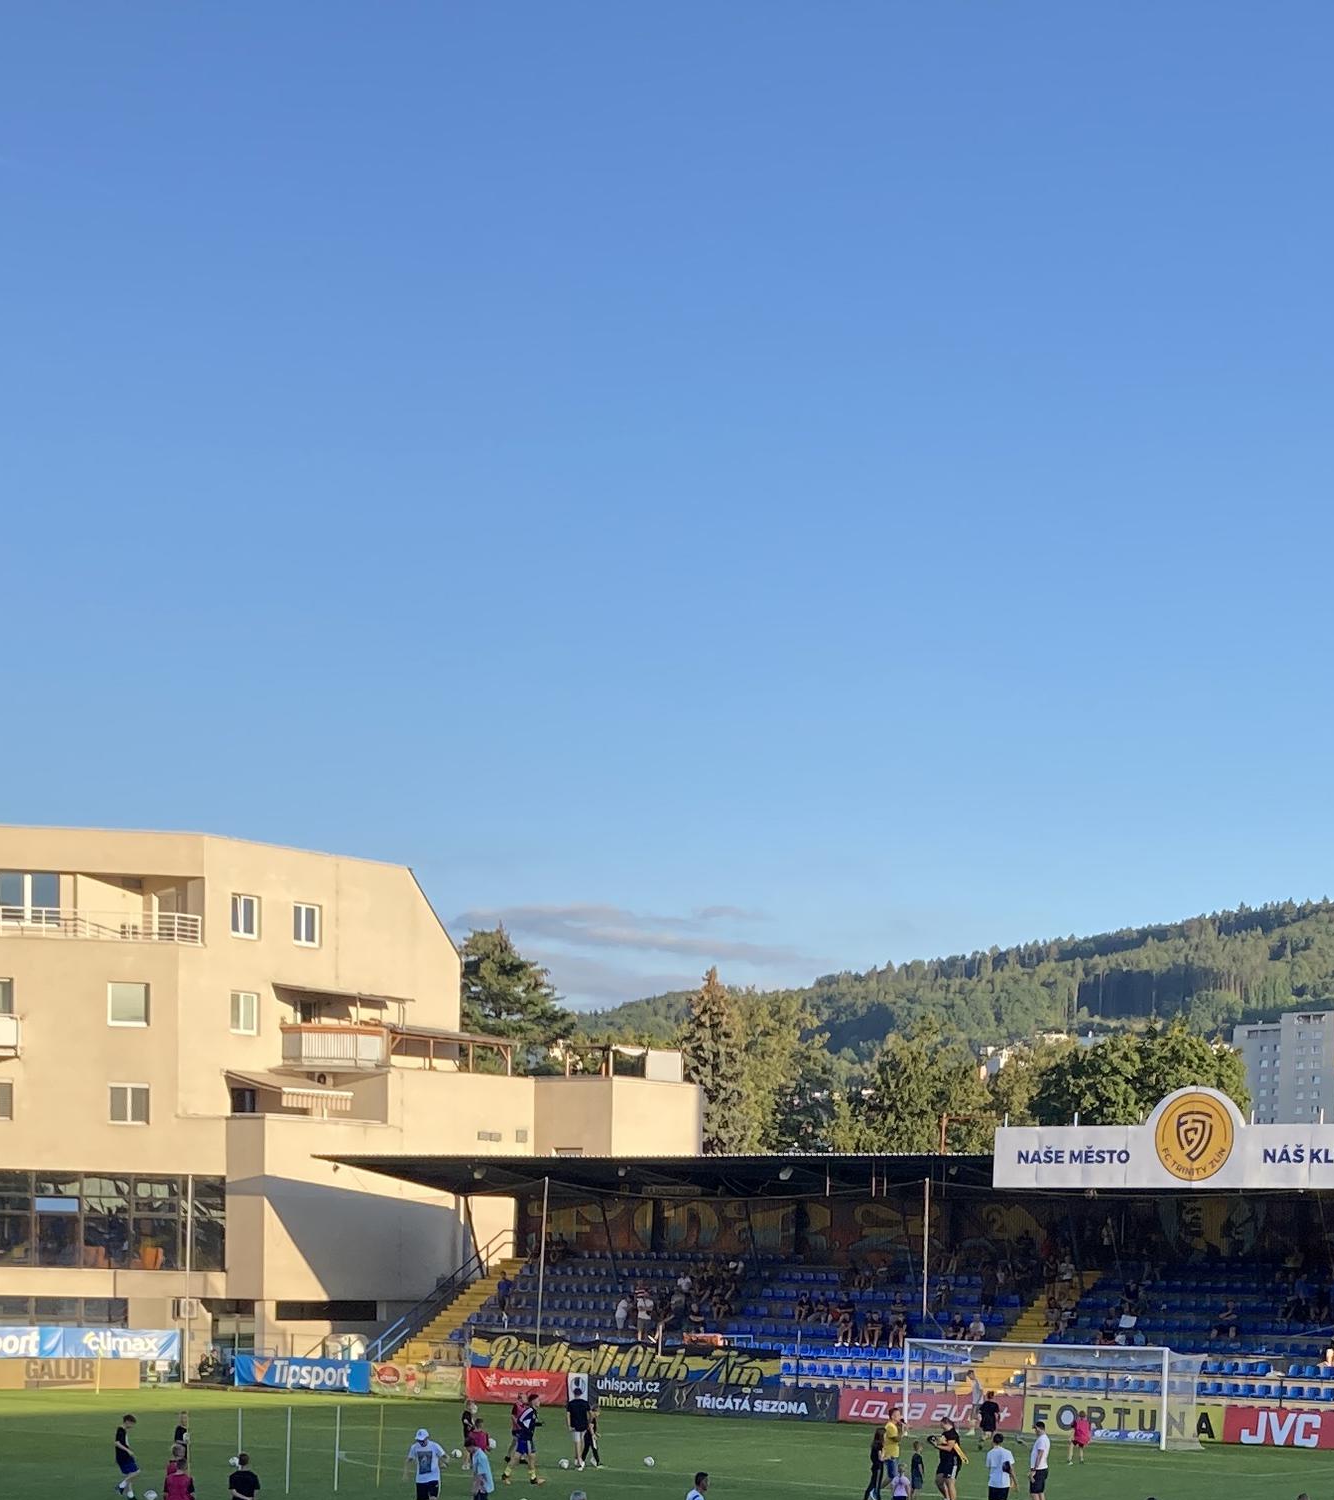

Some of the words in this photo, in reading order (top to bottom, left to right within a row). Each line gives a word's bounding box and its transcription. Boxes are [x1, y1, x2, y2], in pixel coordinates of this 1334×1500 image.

[1017, 1145, 1065, 1164] NAŠE
[1069, 1145, 1130, 1164] MĚSTO
[1162, 1147, 1171, 1161] FC
[1170, 1160, 1207, 1176] TRINITY
[1263, 1144, 1304, 1164] NÁŠ
[87, 1331, 159, 1352] climax
[25, 1359, 94, 1380] GALUR
[273, 1359, 351, 1388] Tipsport
[499, 1377, 549, 1387] AVONET
[596, 1378, 660, 1393] uhlsport.cz
[695, 1393, 751, 1412] TŘICÁTÁ
[754, 1399, 808, 1415] SEZONA
[1033, 1404, 1215, 1439] FORTUNA
[1240, 1411, 1322, 1448] JVC
